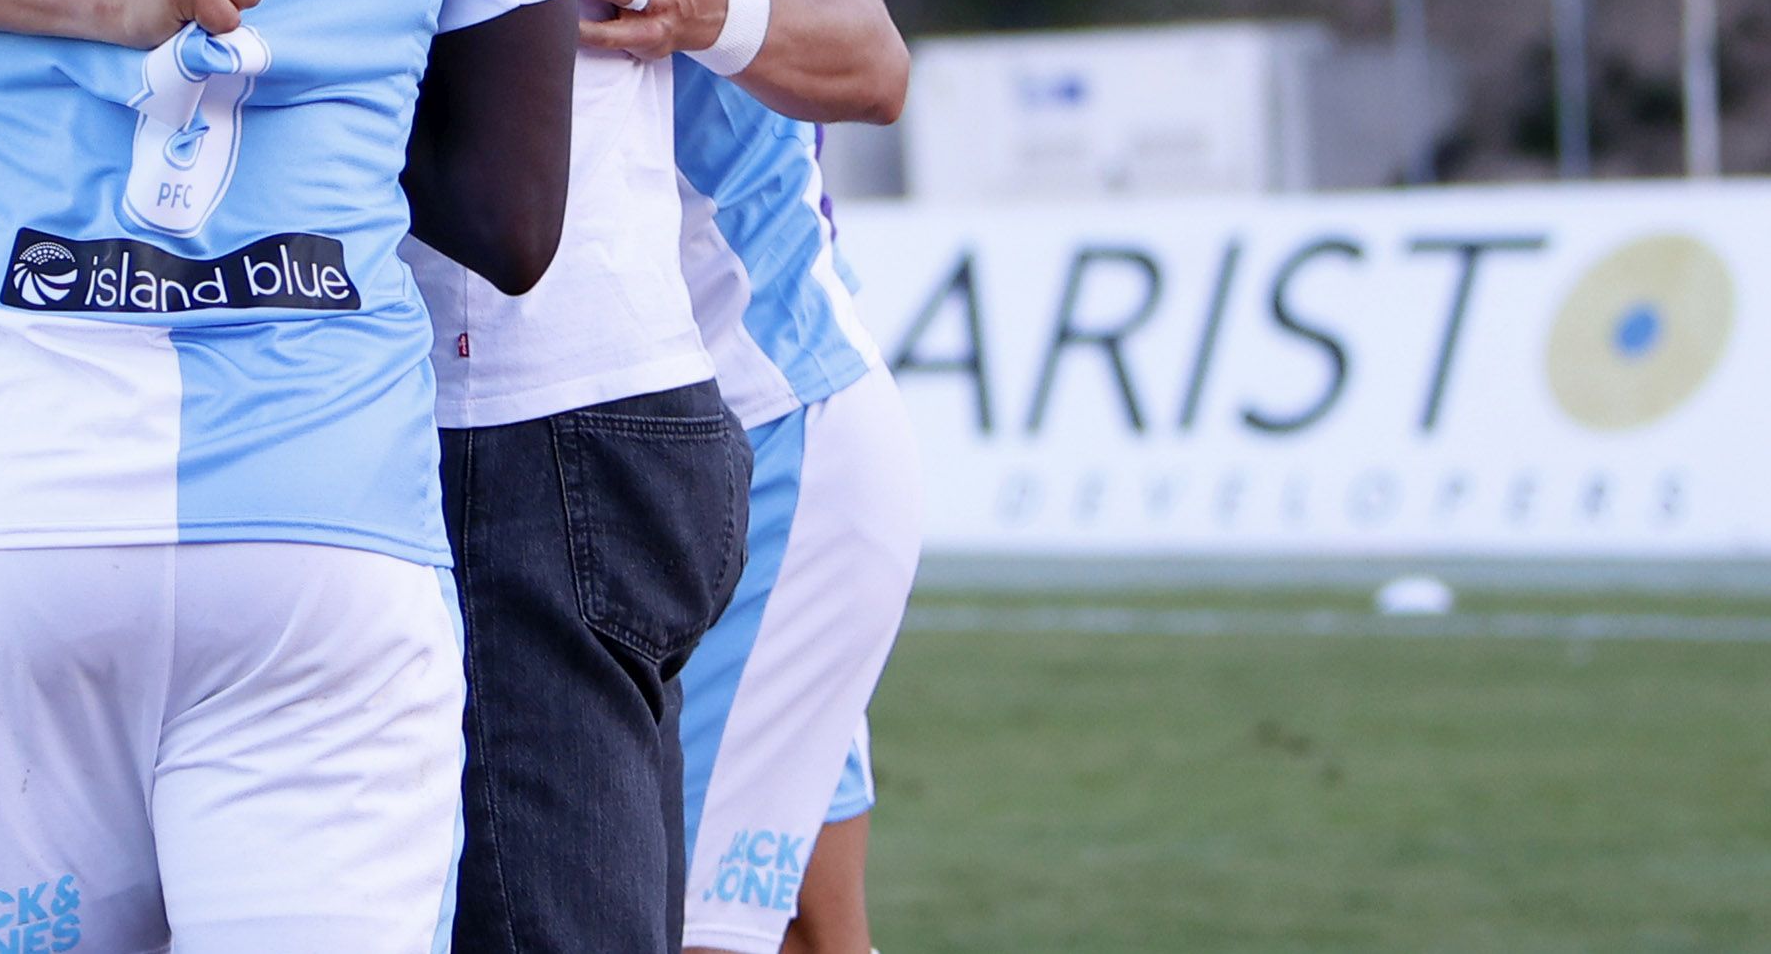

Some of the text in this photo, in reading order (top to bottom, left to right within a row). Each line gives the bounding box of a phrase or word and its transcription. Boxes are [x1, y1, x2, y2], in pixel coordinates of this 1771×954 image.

[156, 182, 192, 210] PFC
[85, 244, 351, 312] island blue
